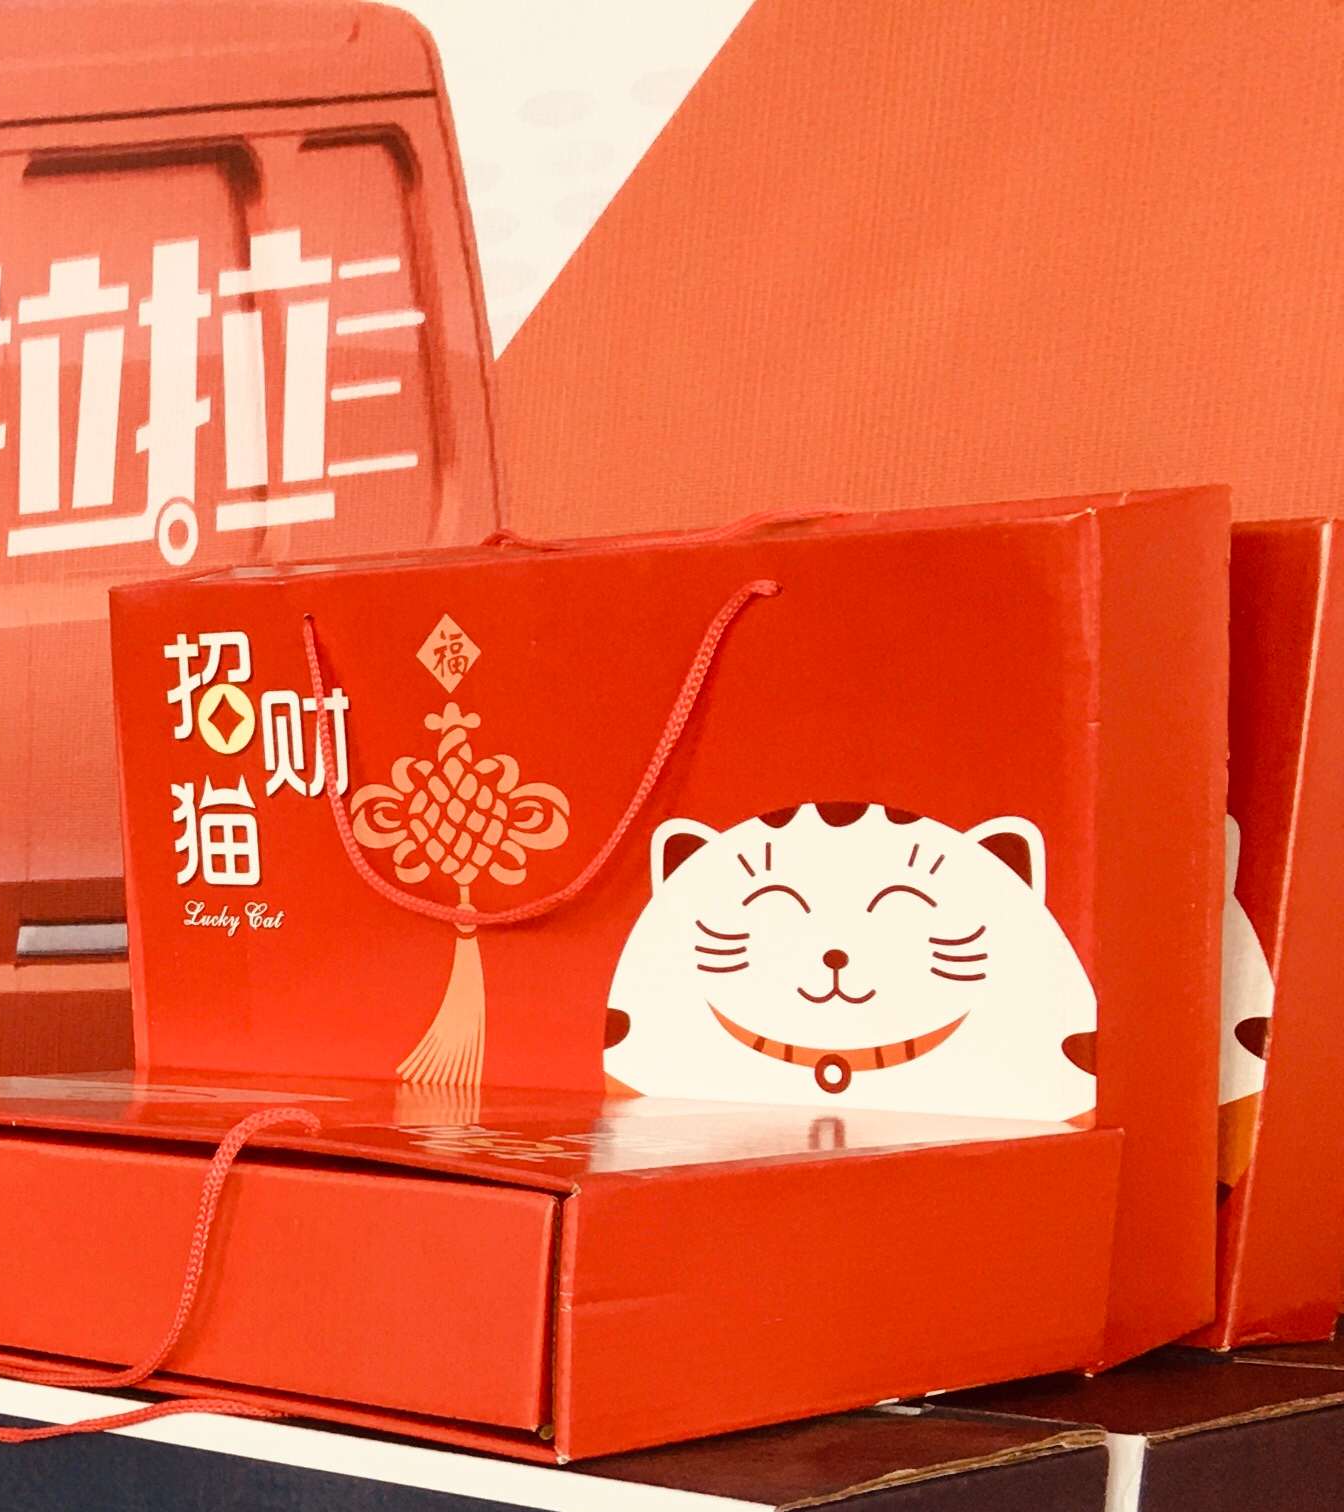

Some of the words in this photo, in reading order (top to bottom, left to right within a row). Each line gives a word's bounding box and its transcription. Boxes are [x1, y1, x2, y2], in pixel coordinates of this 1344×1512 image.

[432, 631, 469, 678] 福
[163, 631, 350, 886] 招财猫
[183, 900, 240, 937] Lucky
[244, 901, 284, 930] Cat
